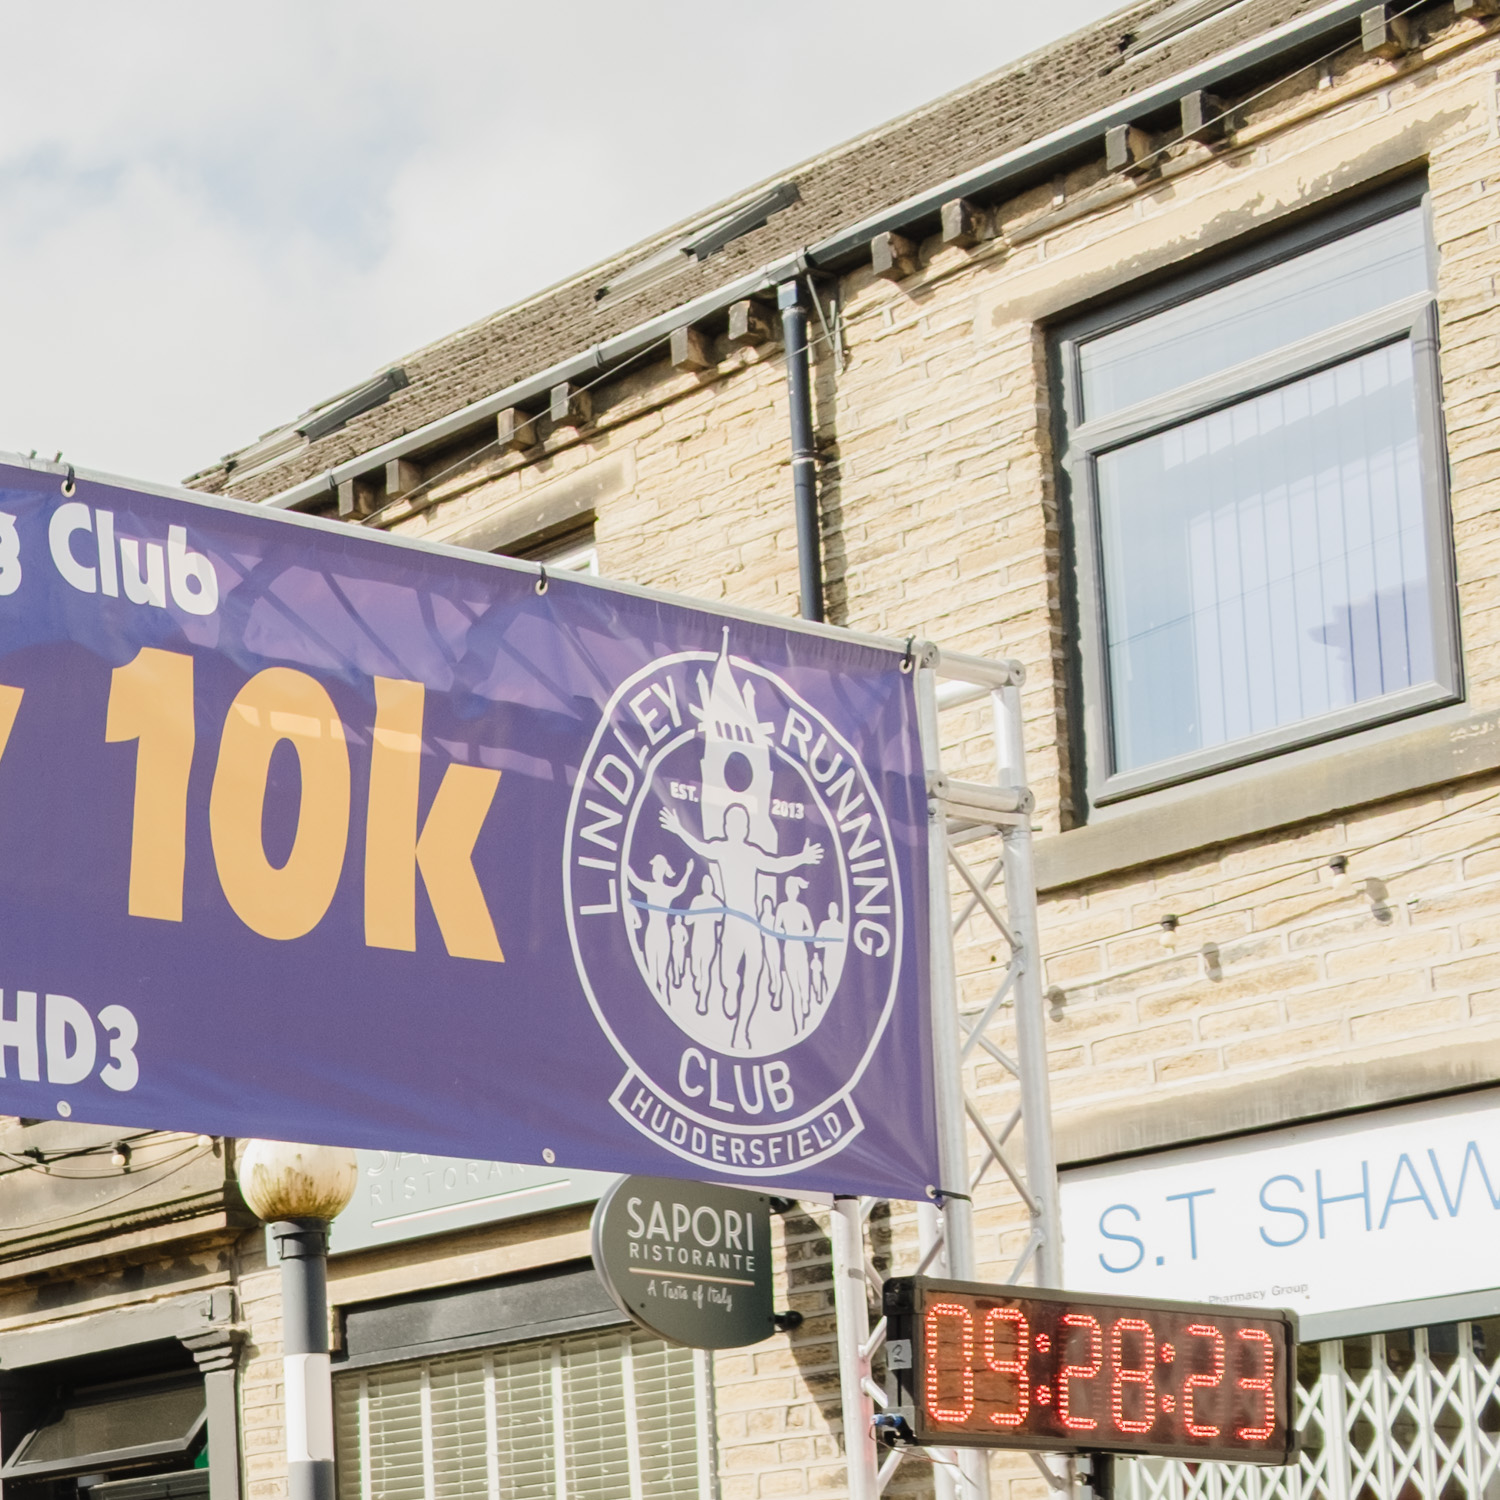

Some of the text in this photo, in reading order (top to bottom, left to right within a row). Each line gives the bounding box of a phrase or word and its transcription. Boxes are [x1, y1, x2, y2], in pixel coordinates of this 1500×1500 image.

[48, 503, 219, 615] Club
[104, 646, 505, 963] 10k
[578, 674, 891, 958] LINDLEY RUNNING
[669, 781, 805, 820] EST. 2013
[677, 1046, 795, 1114] CLUB
[630, 1087, 844, 1167] HUDDERSFIELD
[369, 1162, 526, 1208] RISTORA
[626, 1197, 755, 1252] SAPORI
[629, 1242, 756, 1272] RISTORANTE
[1098, 1187, 1216, 1274] S.T
[647, 1279, 733, 1312] A Taste of Italy
[1208, 1282, 1309, 1305] Pharmacy Group
[925, 1301, 1277, 1441] 09:28:23
